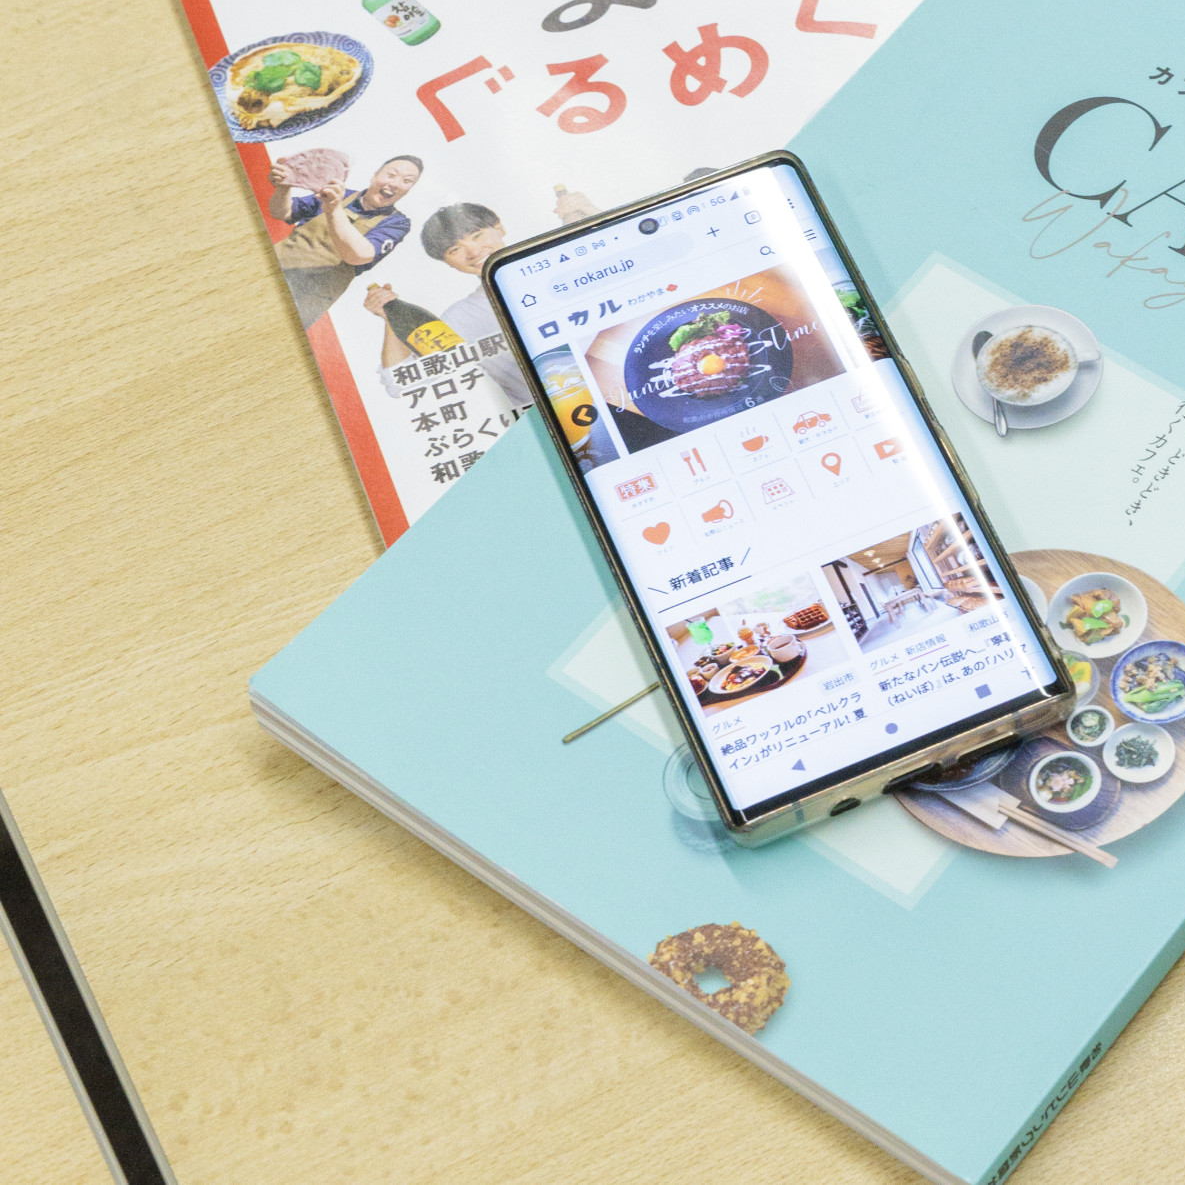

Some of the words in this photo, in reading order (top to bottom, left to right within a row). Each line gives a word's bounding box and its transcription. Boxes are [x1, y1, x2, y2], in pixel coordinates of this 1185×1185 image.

[709, 194, 727, 208] 5G
[519, 257, 552, 279] 11:33
[573, 255, 636, 288] rokaru.jp
[537, 299, 623, 339] ロカル
[626, 286, 666, 308] わかやま
[392, 332, 509, 386] 和歌山駅
[402, 368, 485, 409] アロチ
[411, 400, 468, 433] 本町
[619, 475, 656, 500] 特集
[668, 556, 735, 592] 新着記事
[870, 652, 900, 671] グルメ
[904, 633, 948, 656] 新店情報
[822, 672, 855, 691] 岩出市
[711, 715, 743, 736] グルメ
